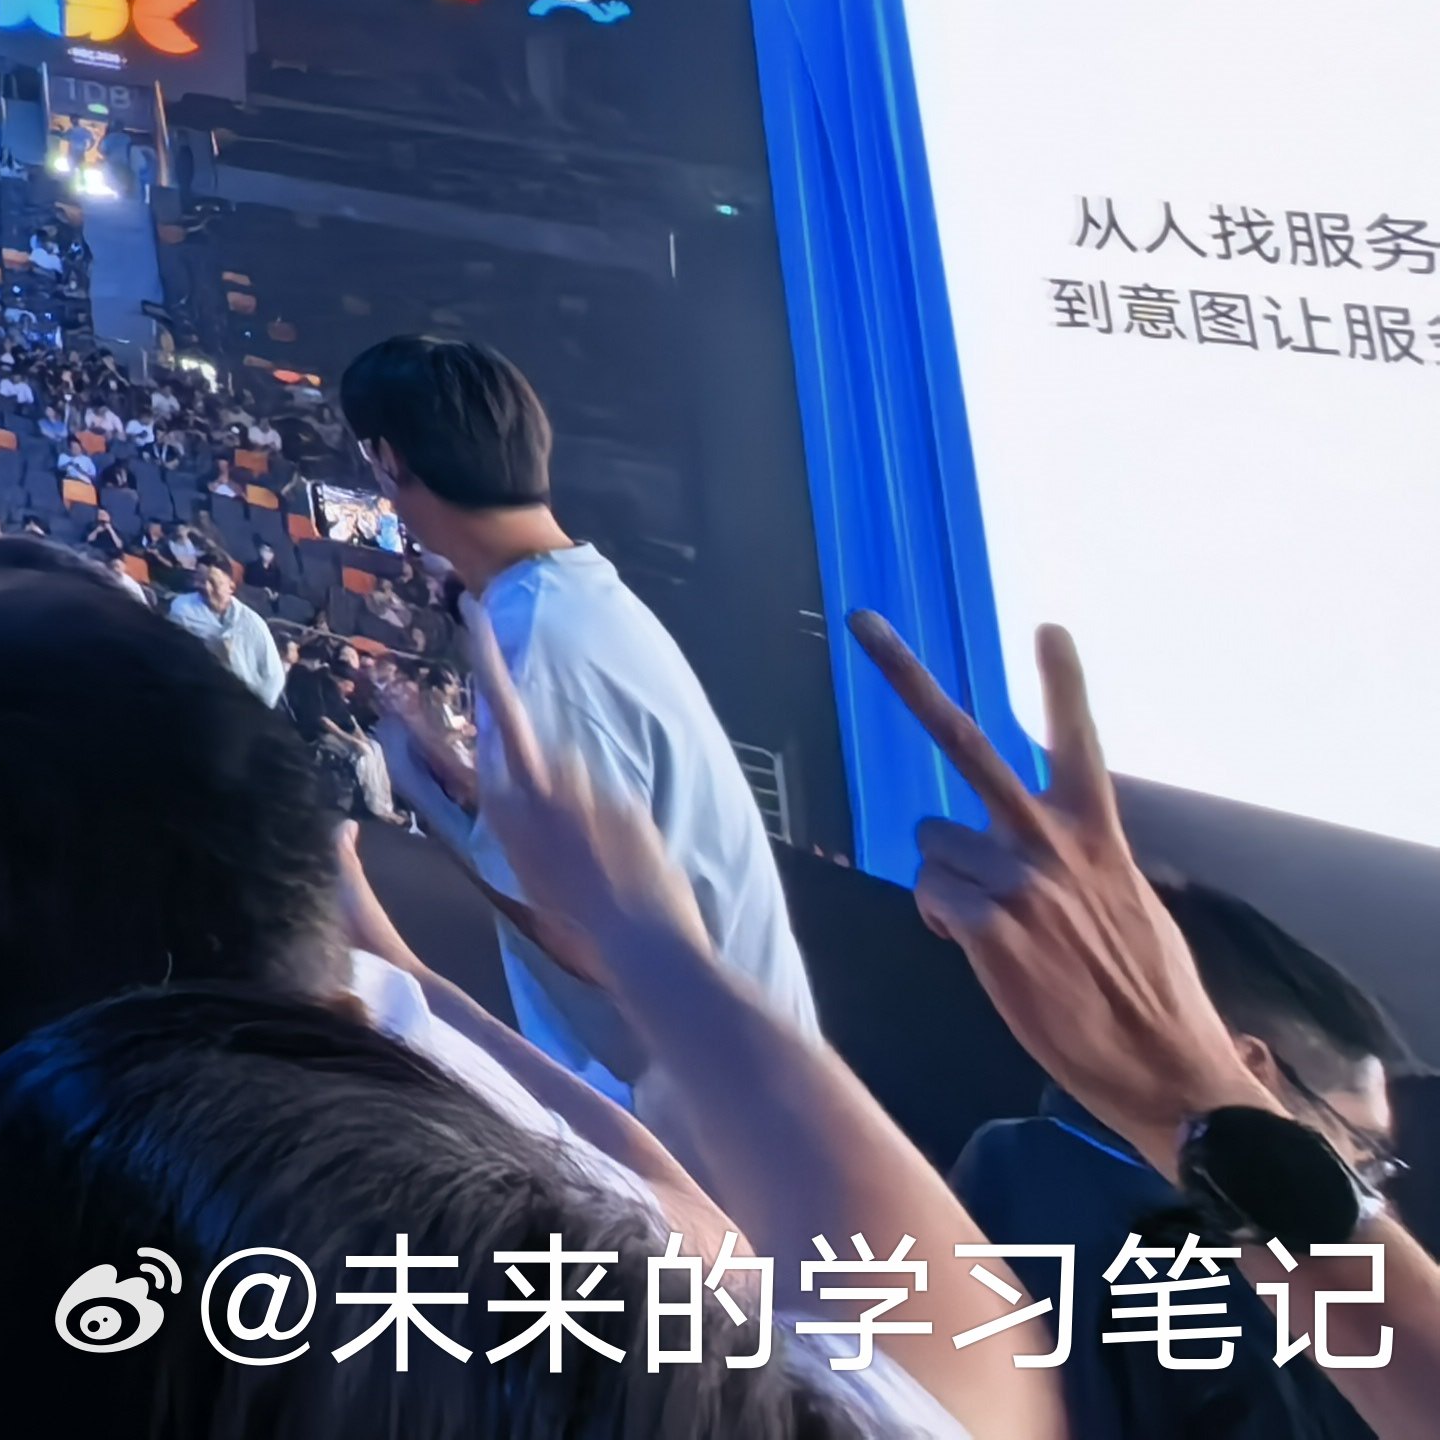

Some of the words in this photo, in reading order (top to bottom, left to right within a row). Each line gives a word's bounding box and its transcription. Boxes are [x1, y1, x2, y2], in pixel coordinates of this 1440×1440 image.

[1077, 195, 1440, 275] 从人找服务
[1047, 278, 1440, 366] 到意图让服
